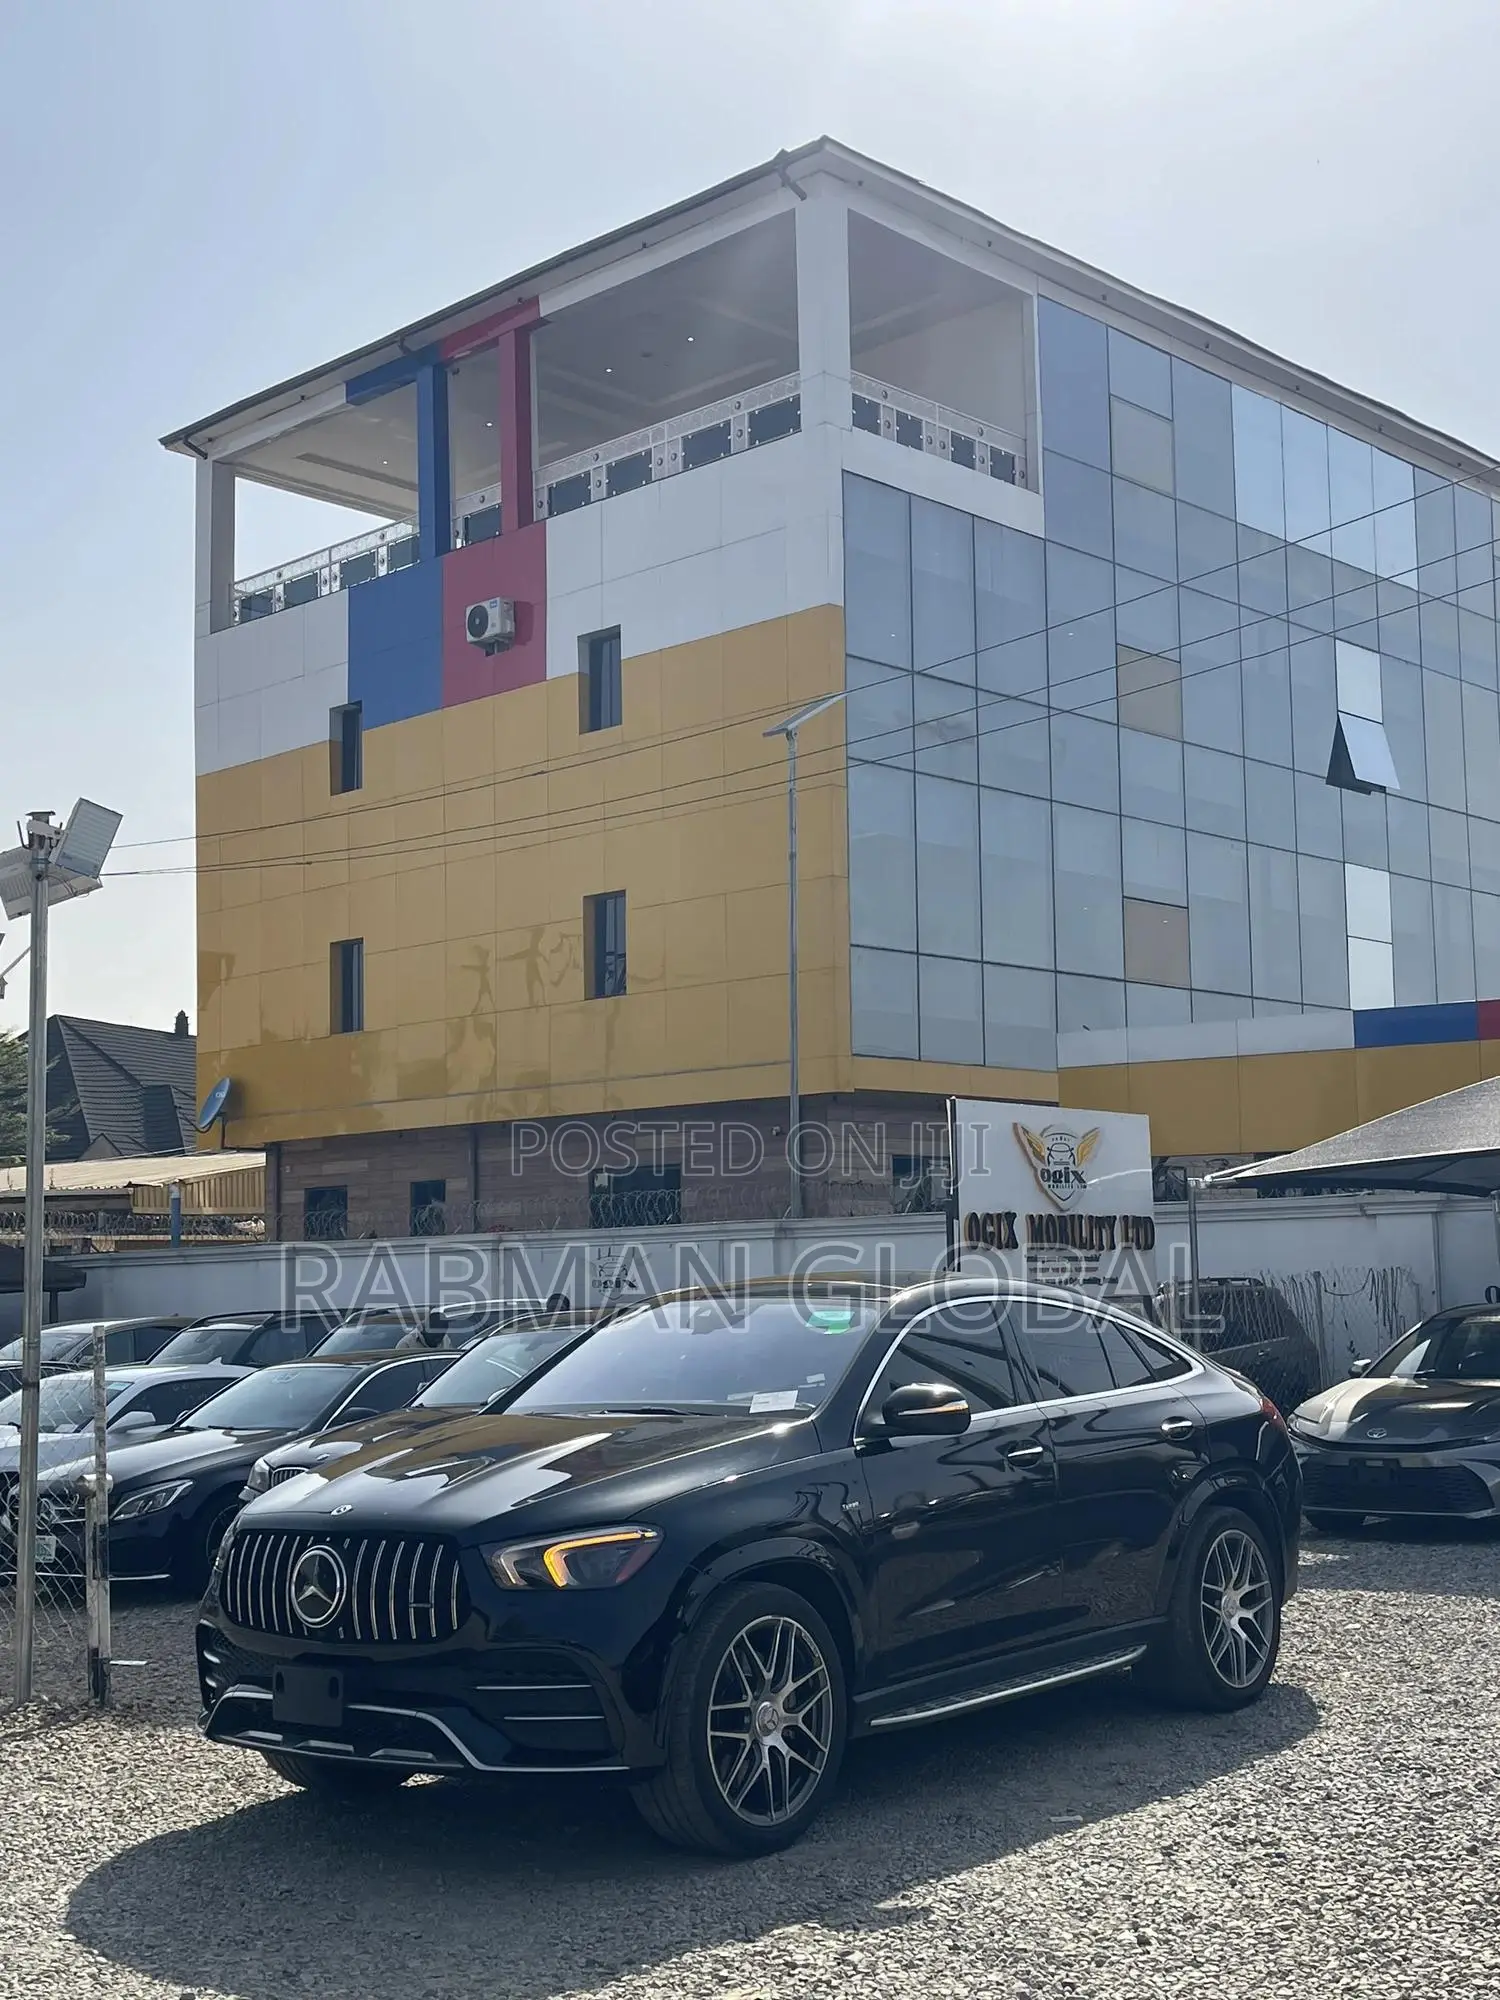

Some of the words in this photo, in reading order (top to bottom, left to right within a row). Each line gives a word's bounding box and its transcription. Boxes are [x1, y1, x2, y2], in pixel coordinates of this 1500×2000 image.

[964, 1211, 1019, 1250] OGIX
[1025, 1213, 1117, 1250] MOBILITY
[1119, 1214, 1155, 1250] LTD
